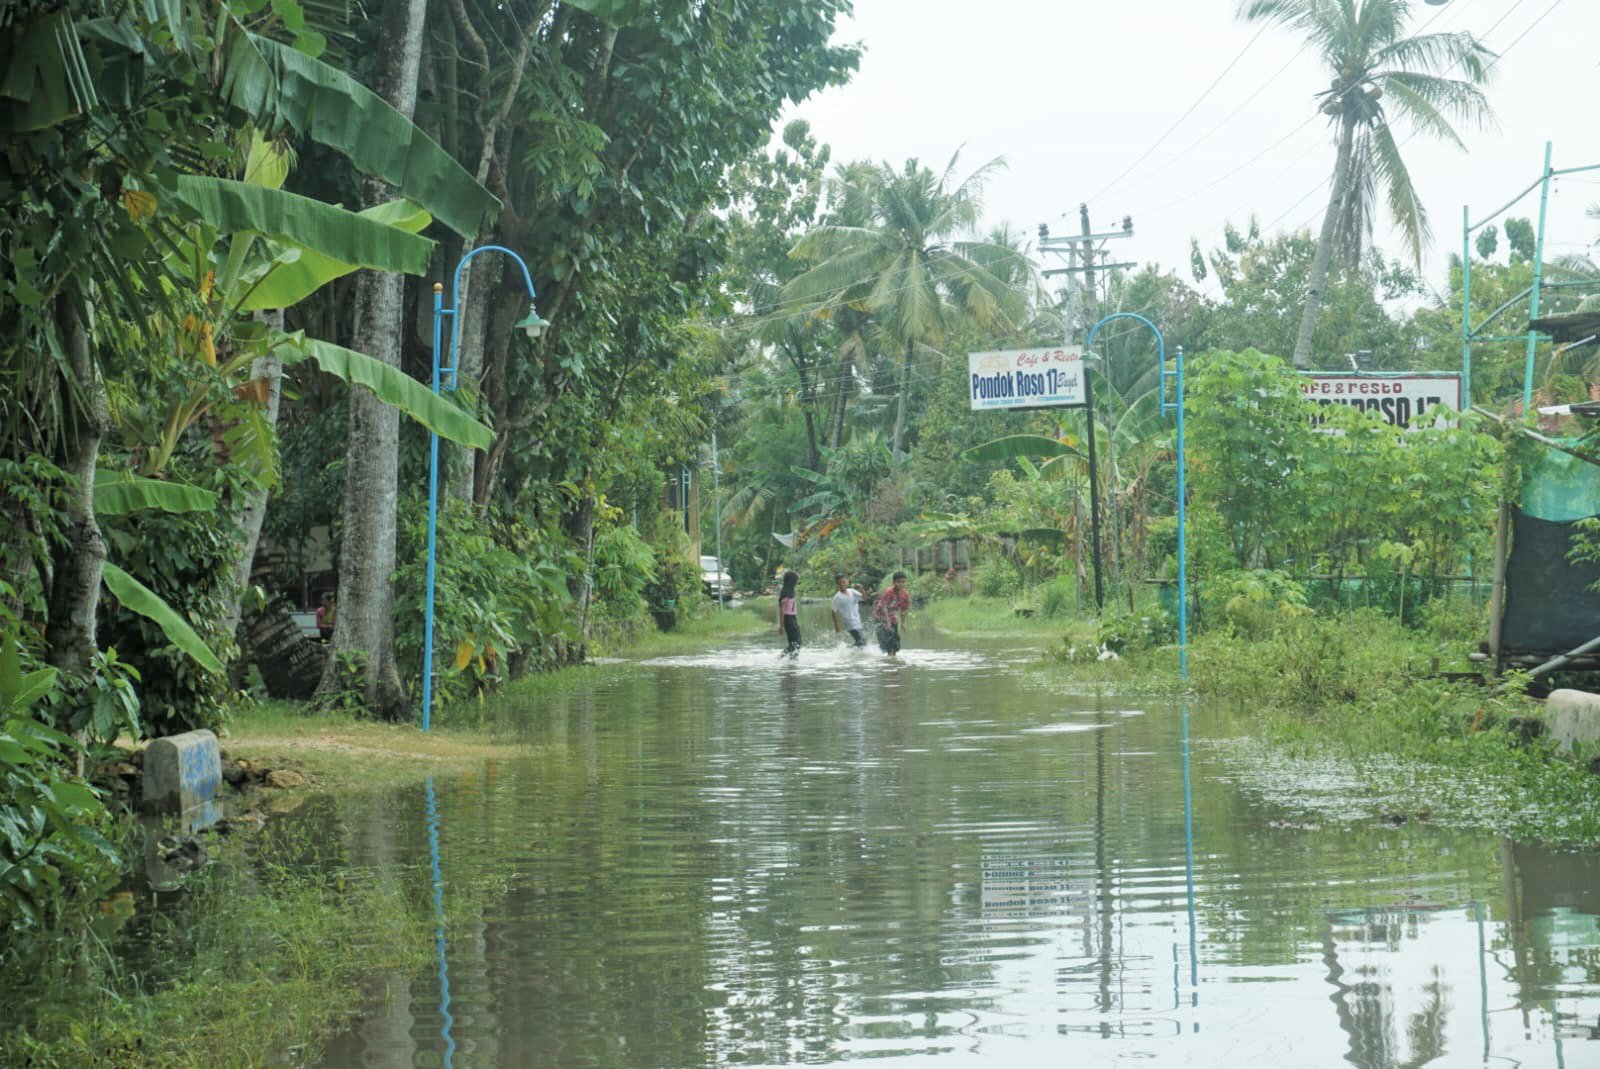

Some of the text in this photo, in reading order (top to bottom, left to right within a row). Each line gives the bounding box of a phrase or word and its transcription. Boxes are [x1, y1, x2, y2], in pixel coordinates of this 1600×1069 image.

[1017, 350, 1079, 367] Cafe & Resto
[972, 371, 1014, 400] Pondok
[1016, 370, 1044, 396] Roso
[1046, 368, 1057, 394] 17
[1335, 383, 1345, 394] &
[1348, 383, 1402, 394] resto
